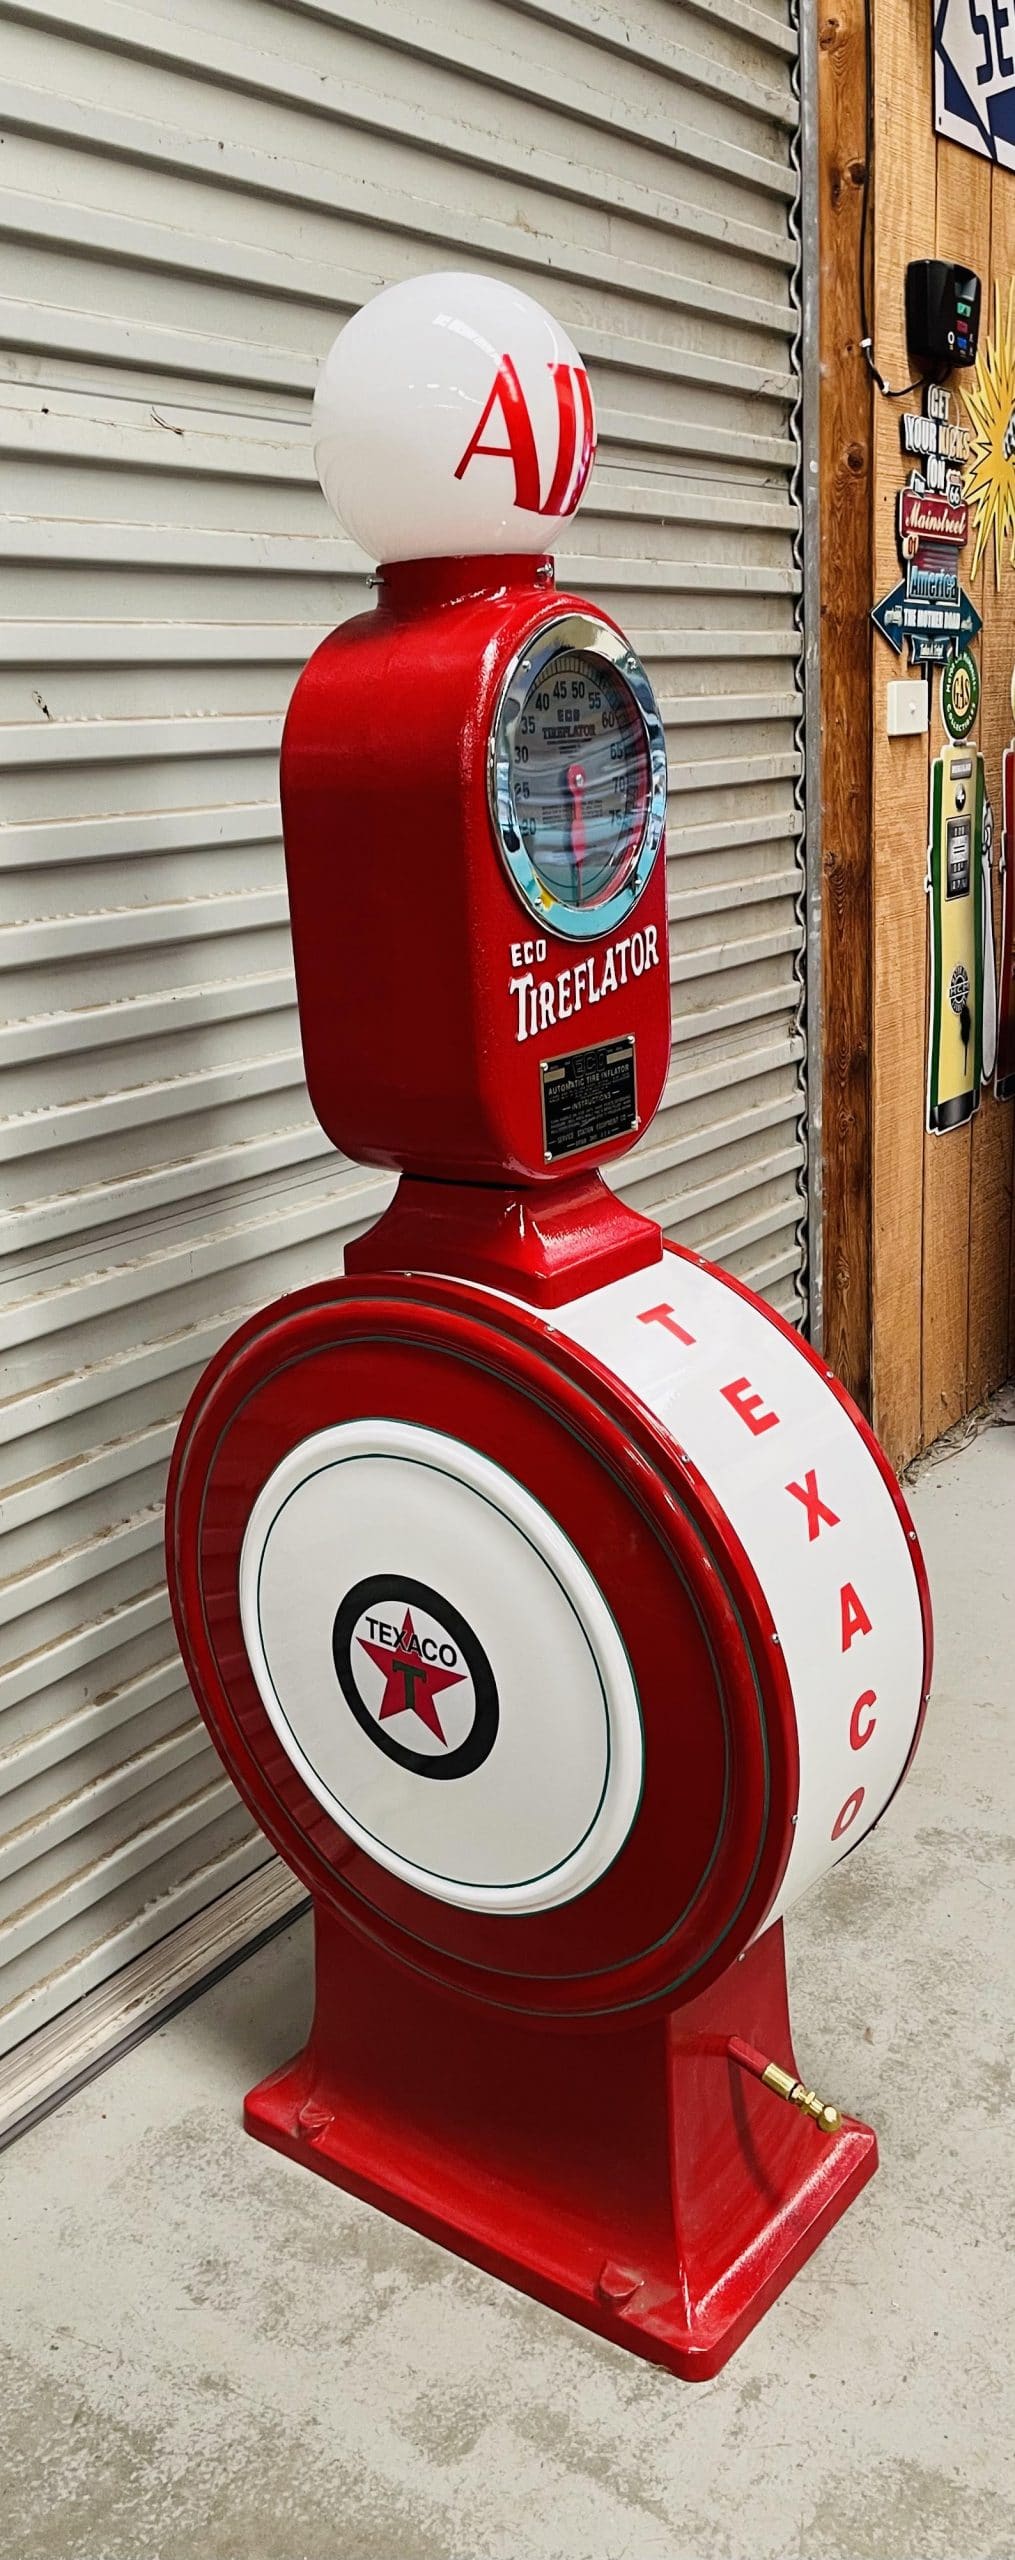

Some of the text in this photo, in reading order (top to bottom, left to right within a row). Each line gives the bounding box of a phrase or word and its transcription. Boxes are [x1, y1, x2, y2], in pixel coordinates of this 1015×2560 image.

[968, 0, 1015, 86] SE
[930, 387, 951, 420] GET
[905, 416, 937, 453] YOUR
[928, 456, 946, 490] ON
[949, 485, 961, 504] 66
[905, 501, 966, 534] Mainstreet
[909, 565, 958, 600] America
[535, 693, 549, 711] 40
[553, 681, 585, 699] 45 50
[588, 692, 602, 710] 55
[521, 716, 536, 734] 35
[602, 711, 615, 729] 60
[514, 746, 529, 763] 30
[610, 743, 623, 760] 65
[514, 782, 530, 799] 25
[612, 776, 625, 794] 70
[510, 939, 547, 967] ECO
[509, 925, 659, 1041] TIREFLATOR
[548, 1079, 585, 1095] AUTOMATIC
[586, 1073, 600, 1084] TIRE
[601, 1063, 630, 1079] INFLATOR
[636, 1302, 878, 1842] TEXACO
[365, 1616, 458, 1668] TEXACO
[392, 1659, 427, 1709] T
